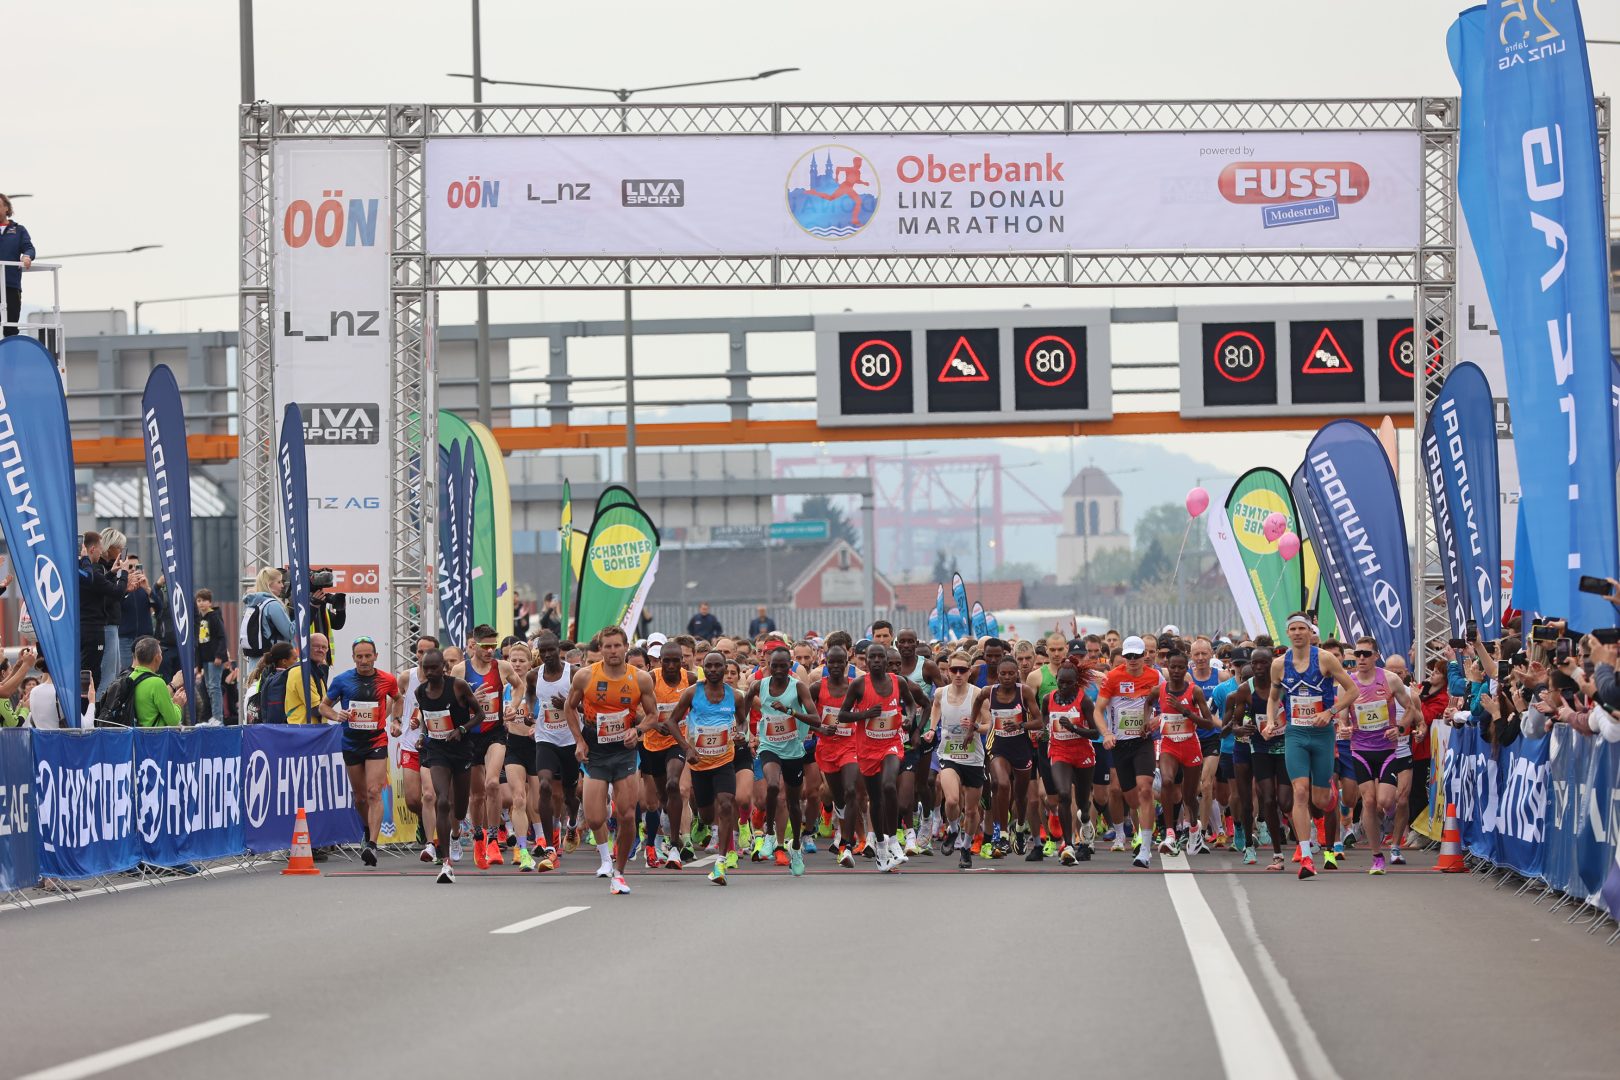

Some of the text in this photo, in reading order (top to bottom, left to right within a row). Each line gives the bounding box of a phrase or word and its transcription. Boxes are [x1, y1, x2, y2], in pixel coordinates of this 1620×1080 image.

[1199, 146, 1255, 157] powered by
[896, 153, 1064, 183] Oberbank
[626, 181, 680, 195] LIVA
[1235, 167, 1358, 198] FUSSL
[447, 176, 500, 209] OÖN
[626, 196, 680, 204] SPORT
[898, 191, 953, 209] LINZ
[970, 190, 1065, 208] DONAU
[1271, 204, 1331, 221] Modestraße
[283, 190, 379, 248] OÖN
[898, 215, 1065, 235] MARATHON
[1035, 349, 1065, 373] 80
[1225, 345, 1253, 368] 80
[860, 354, 890, 377] 80
[302, 408, 374, 428] IVA
[344, 497, 379, 509] AG
[590, 540, 652, 560] SCHARTNER
[603, 555, 641, 572] BOMBE
[352, 570, 378, 585] OÖ
[349, 596, 380, 605] lieben
[353, 711, 372, 719] PACE
[1297, 707, 1315, 716] 1708
[1367, 713, 1379, 721] 2A
[546, 722, 568, 730] Oberba
[605, 722, 625, 733] 1794
[1294, 718, 1313, 726] Oberba
[775, 725, 785, 733] 28
[1171, 724, 1181, 732] 17
[601, 735, 625, 743] Oberba
[768, 733, 796, 742] Oberbank
[867, 730, 895, 739] Oberbank
[706, 737, 717, 745] 27
[698, 747, 725, 755] Oberbank
[949, 743, 966, 751] 576
[277, 752, 353, 816] HYUND
